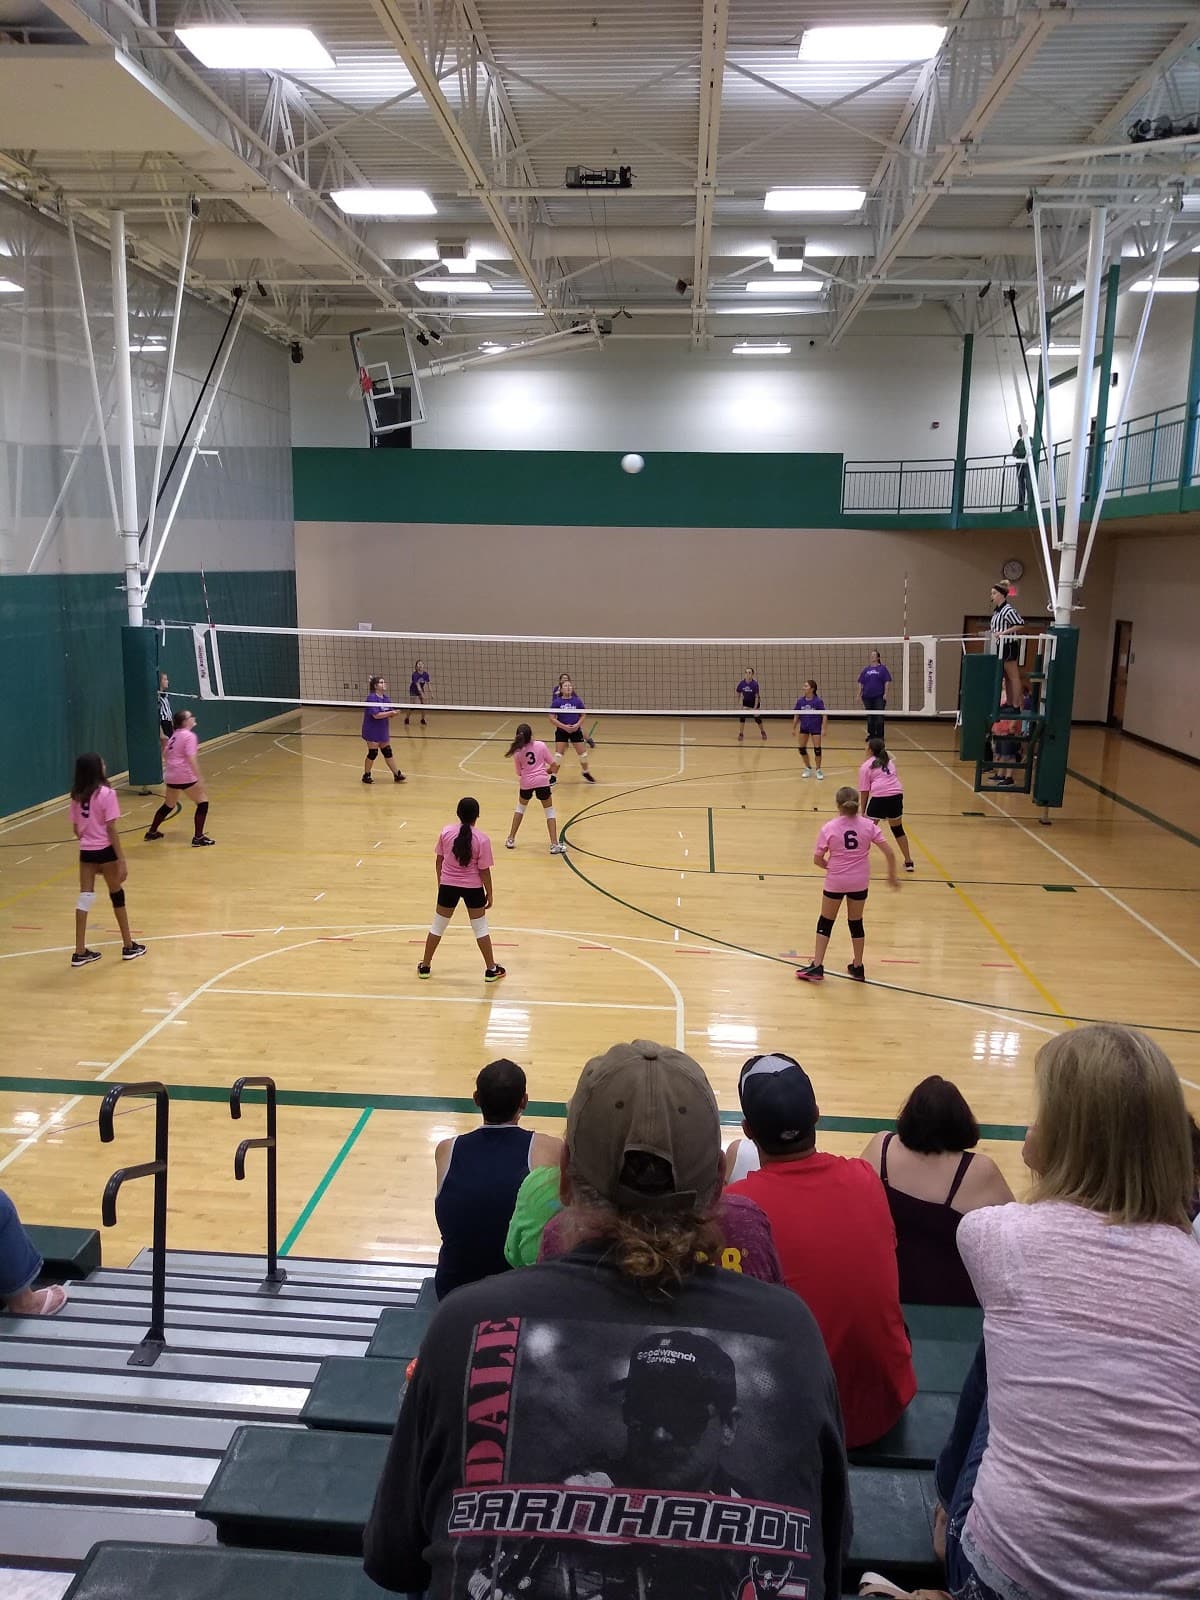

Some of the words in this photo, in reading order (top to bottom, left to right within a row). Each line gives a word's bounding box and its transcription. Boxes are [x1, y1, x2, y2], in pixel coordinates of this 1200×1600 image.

[525, 751, 536, 765] 3
[843, 830, 859, 850] 6
[464, 1316, 521, 1487] DALE
[448, 1490, 811, 1553] EARNHARDT
